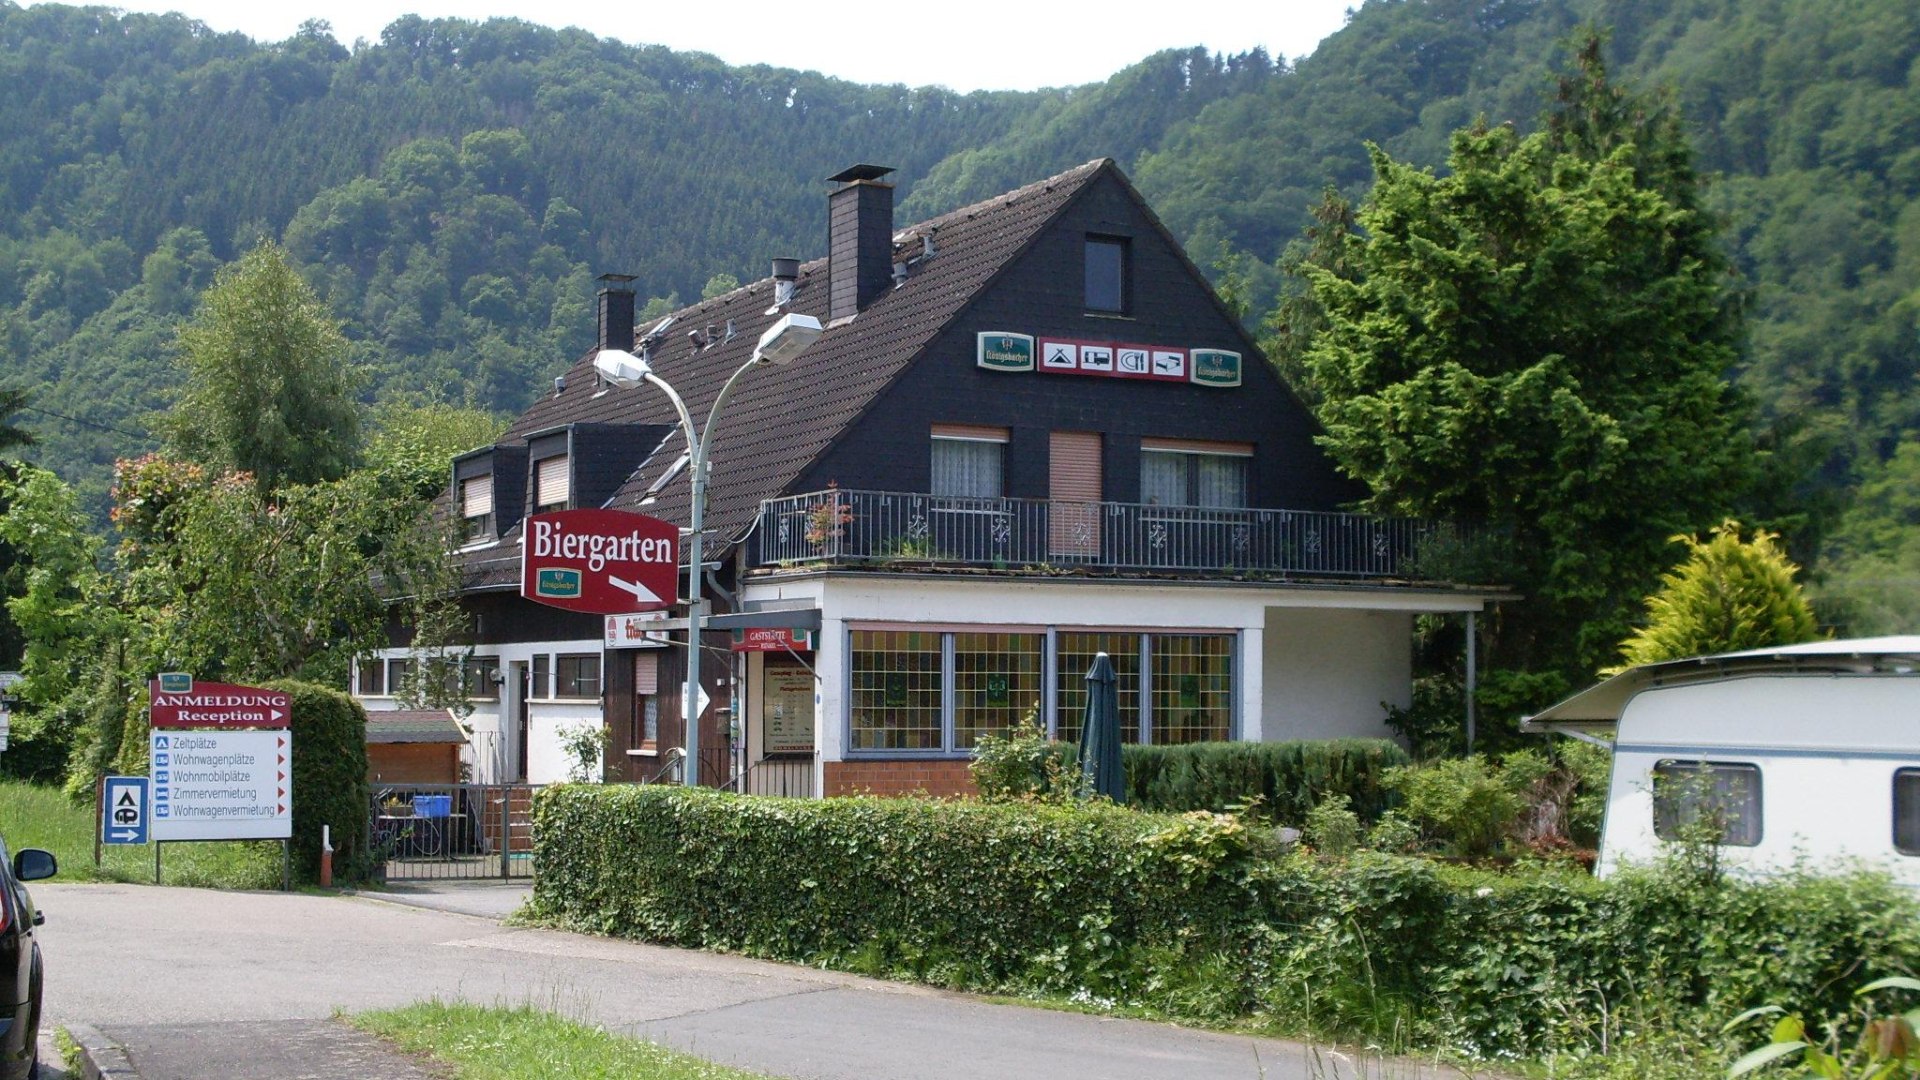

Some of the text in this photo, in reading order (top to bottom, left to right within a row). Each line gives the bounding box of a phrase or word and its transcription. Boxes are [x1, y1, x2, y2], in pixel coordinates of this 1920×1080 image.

[534, 521, 672, 572] Biergarten
[153, 695, 286, 706] ANMELDUNG
[178, 710, 264, 723] Reception
[173, 738, 217, 751] Zeltplätze
[173, 754, 255, 768] Wohnwagenplätze
[173, 771, 251, 784] Wohnmobilplätze
[173, 787, 257, 801] Zimmervermietung
[173, 804, 275, 818] Wohnwagenvermietung
